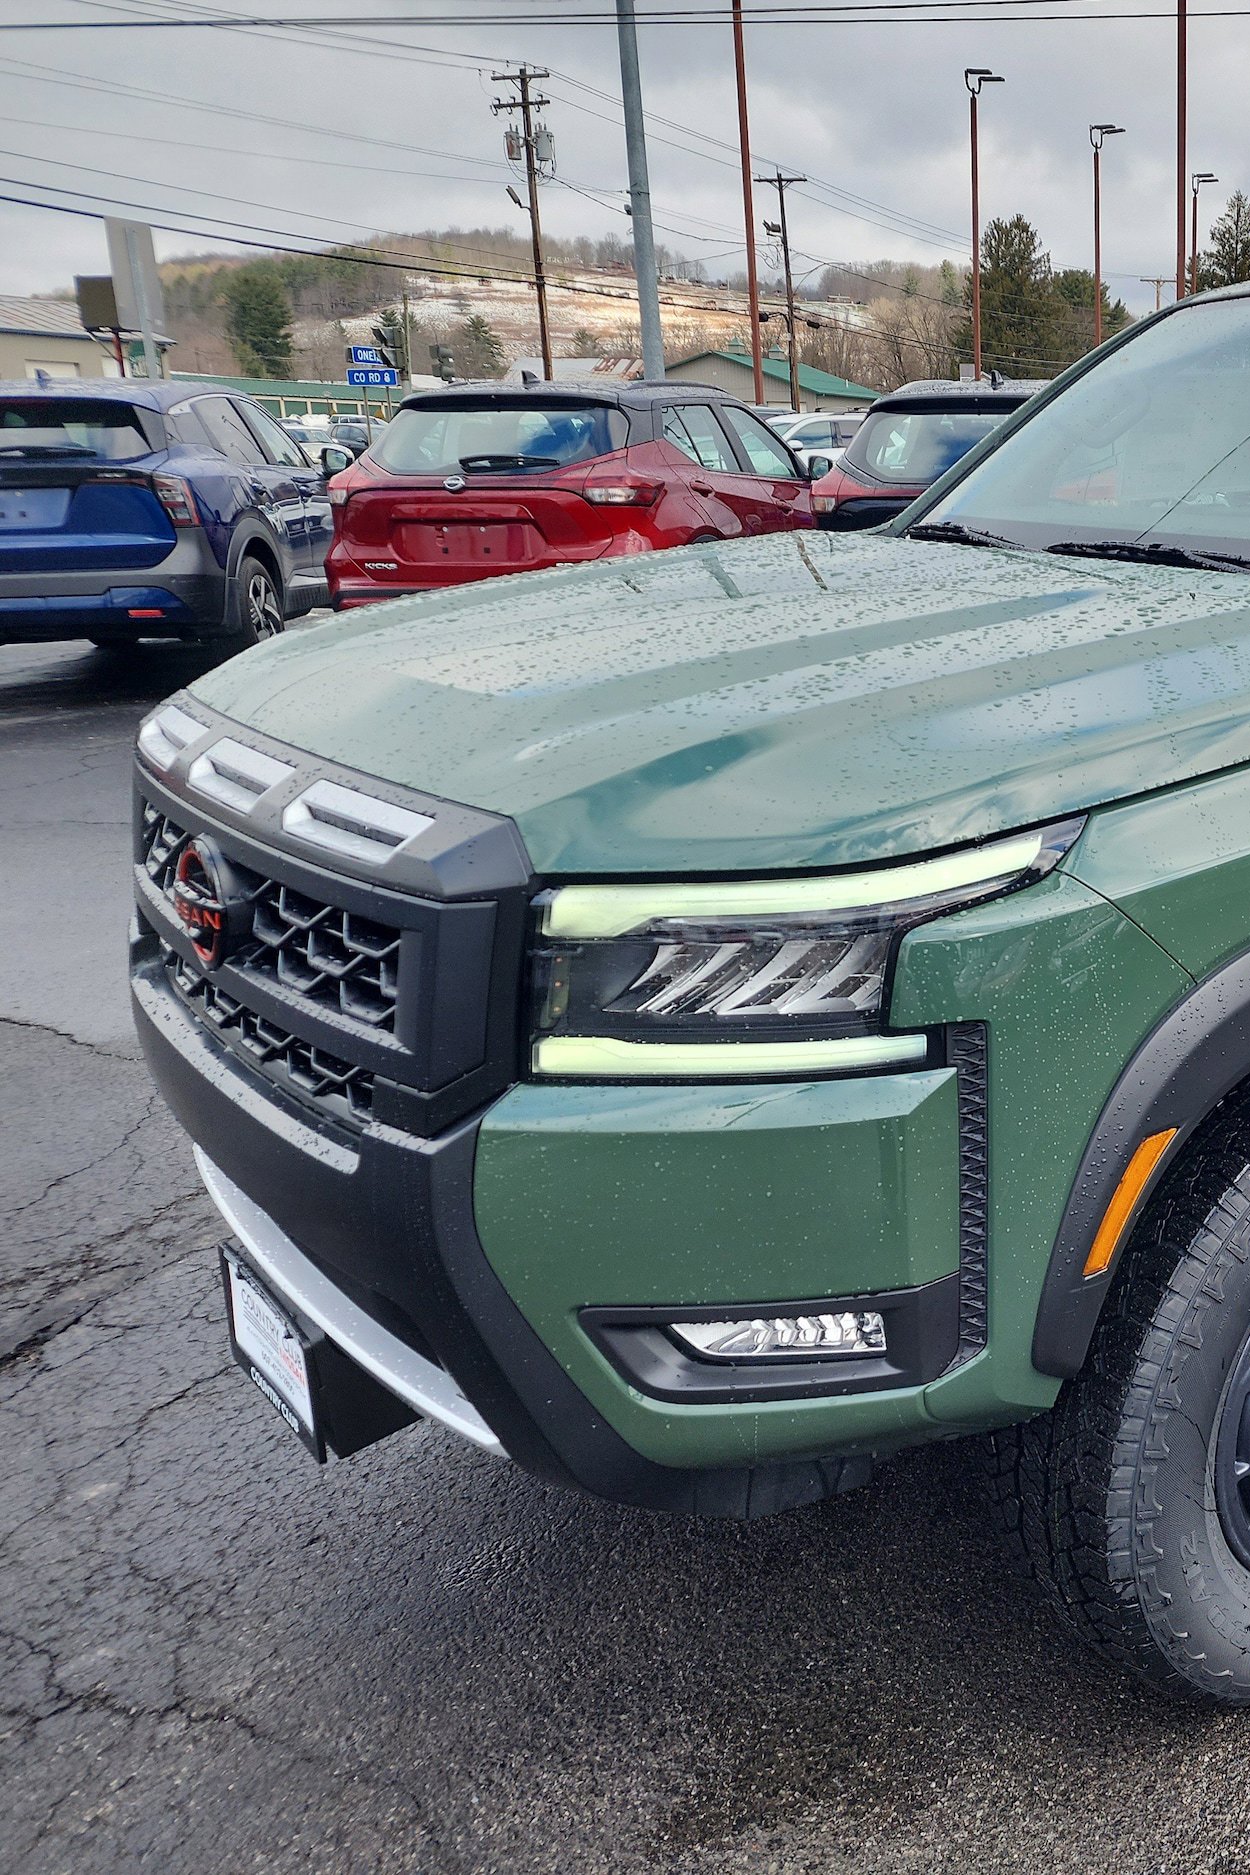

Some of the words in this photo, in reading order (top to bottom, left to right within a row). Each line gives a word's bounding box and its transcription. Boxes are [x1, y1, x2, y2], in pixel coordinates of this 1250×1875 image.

[353, 372, 366, 383] CO
[368, 372, 381, 383] RD
[383, 372, 391, 383] 8
[364, 562, 398, 571] KICKS
[240, 1287, 280, 1343] COUNTRY
[281, 1337, 303, 1372] CLUB
[250, 1366, 282, 1411] COUNTRY
[280, 1403, 300, 1434] CLUB
